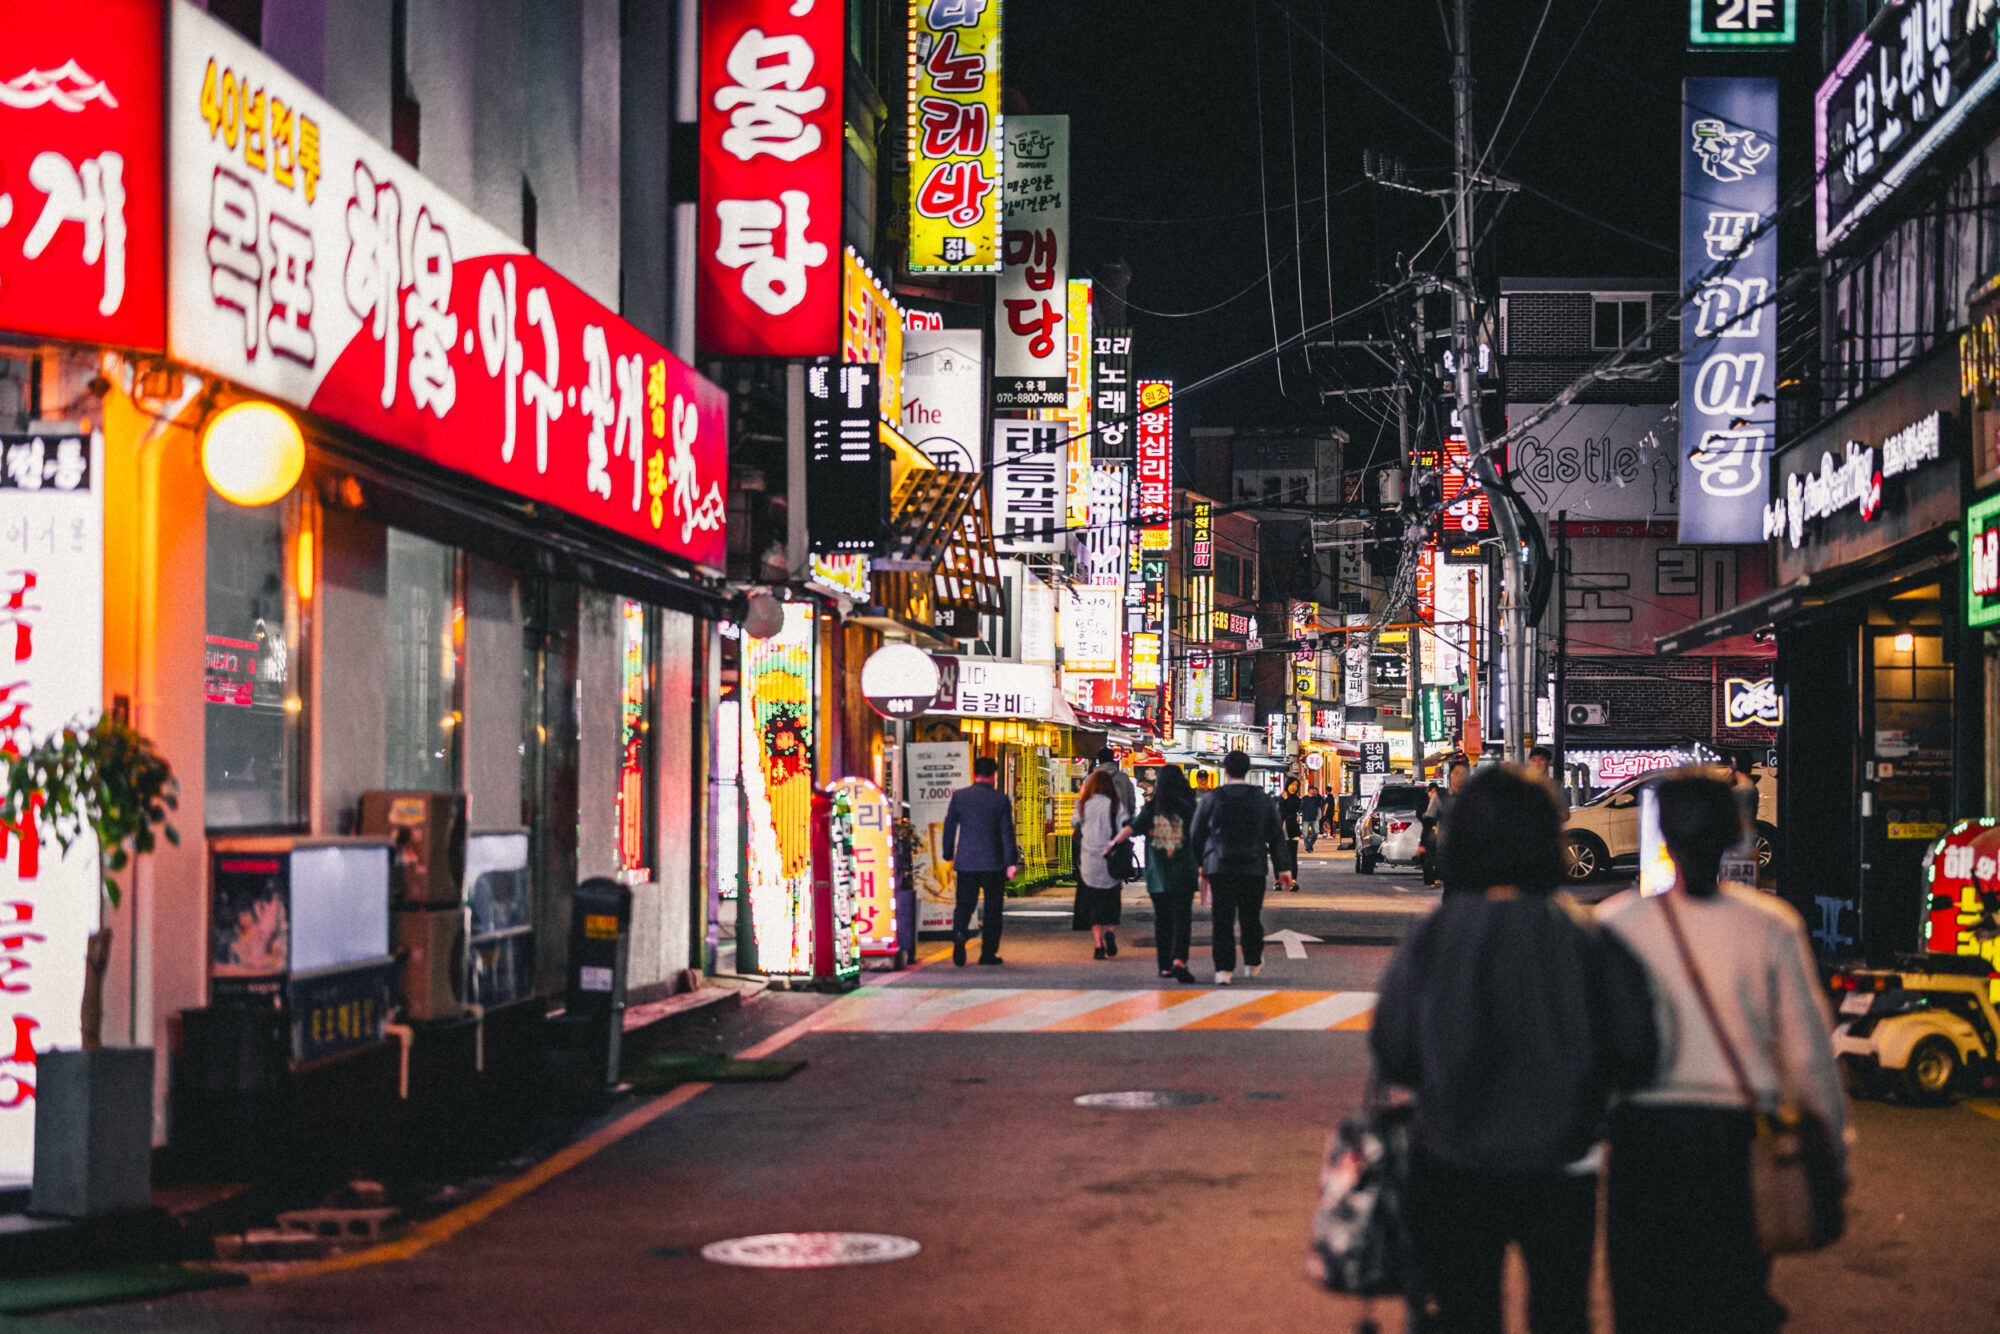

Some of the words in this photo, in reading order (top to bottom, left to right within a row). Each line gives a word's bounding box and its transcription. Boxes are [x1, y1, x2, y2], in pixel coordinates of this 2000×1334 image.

[1716, 0, 1775, 29] 2F
[200, 57, 321, 205] 40년전통
[714, 0, 828, 317] 물탕
[945, 238, 964, 261] 지하
[206, 165, 318, 368] 목포
[1002, 227, 1064, 359] 맵당
[1093, 337, 1131, 355] 꼬리
[997, 393, 1065, 404] 070-8800-7666
[1014, 380, 1047, 391] 수유점
[903, 397, 942, 424] The
[1515, 435, 1639, 505] Castle
[1002, 428, 1059, 546] 태능갈비
[1193, 541, 1210, 567] 비어
[1230, 613, 1248, 635] BEER
[1365, 743, 1384, 755] 진심
[1365, 761, 1385, 773] 참치
[919, 788, 956, 799] 7.000
